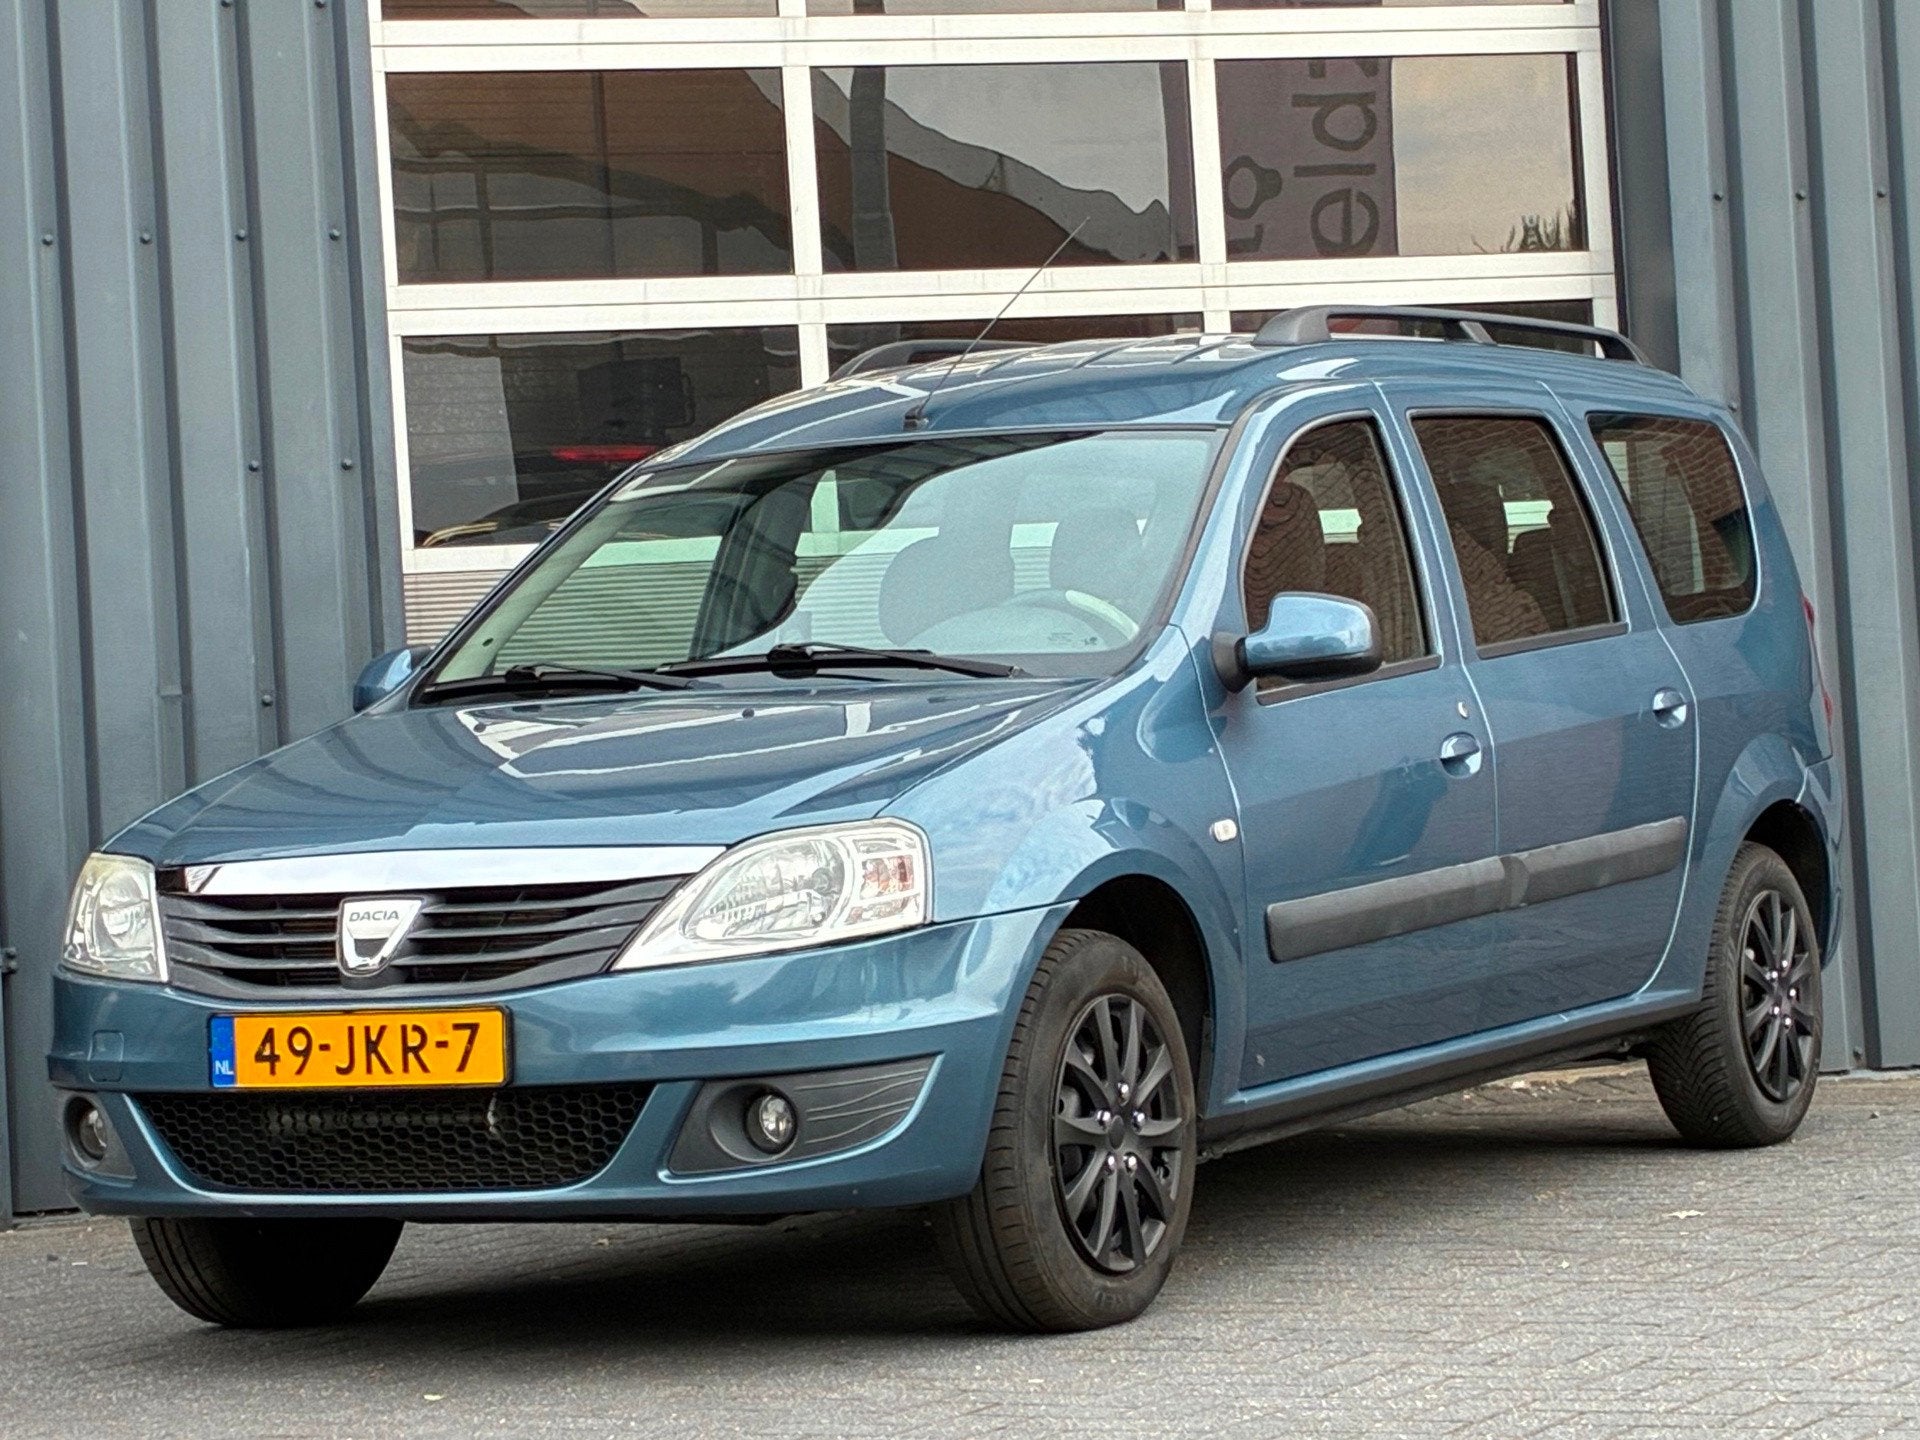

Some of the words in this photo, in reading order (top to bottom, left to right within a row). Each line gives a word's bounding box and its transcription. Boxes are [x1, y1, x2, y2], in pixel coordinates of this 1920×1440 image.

[349, 910, 399, 922] DACIA
[214, 1060, 234, 1076] NL
[254, 1022, 480, 1076] 49-JKR-7
